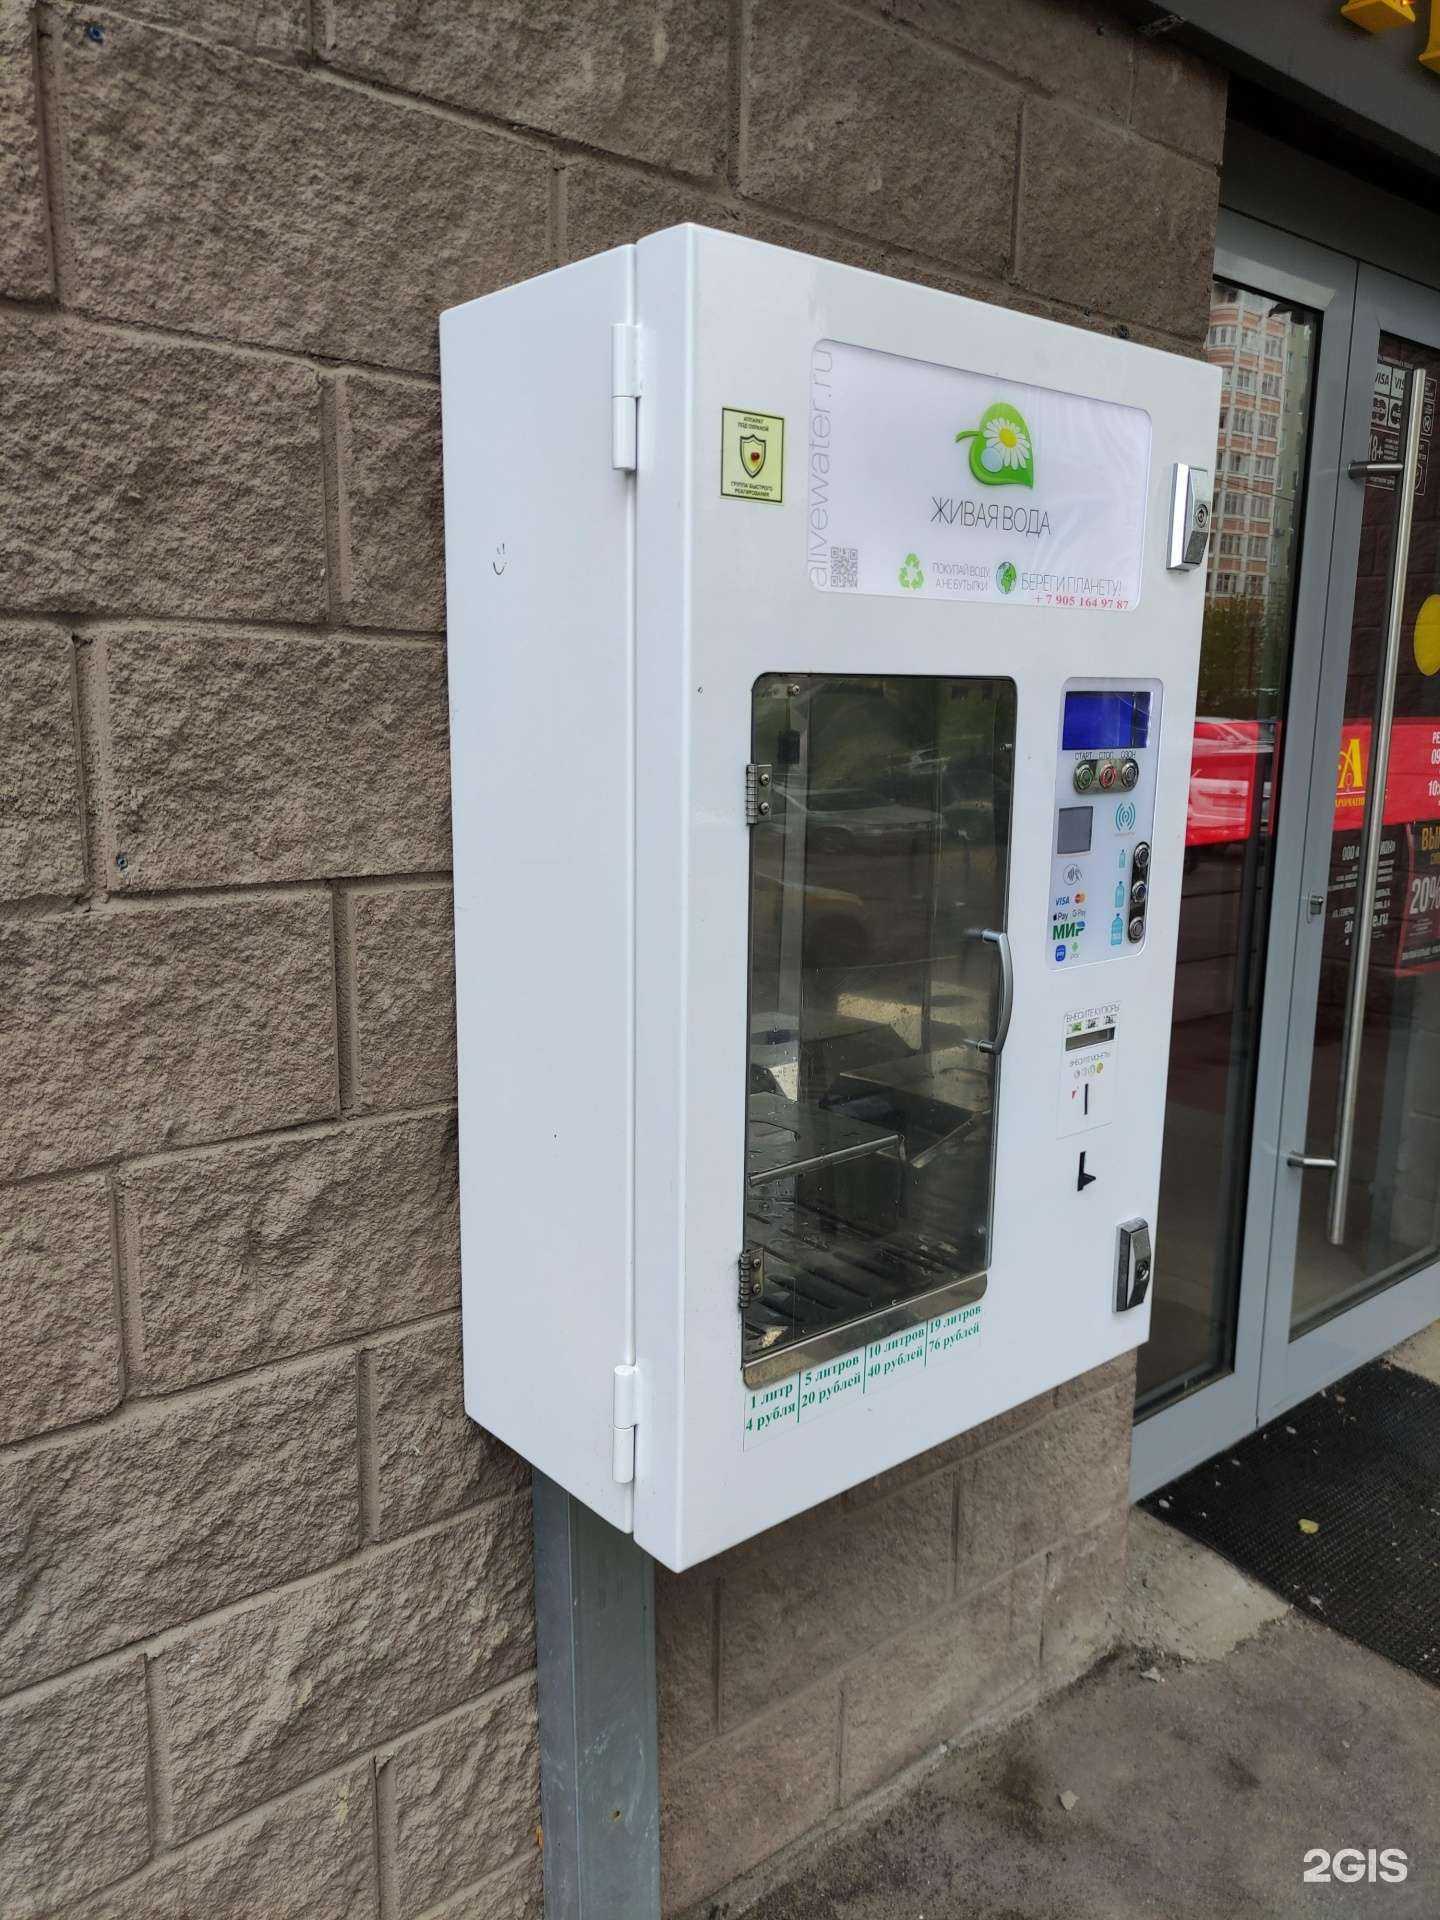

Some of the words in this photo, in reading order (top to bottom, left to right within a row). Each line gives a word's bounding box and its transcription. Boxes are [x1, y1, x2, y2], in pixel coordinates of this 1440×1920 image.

[808, 347, 833, 587] alivewater.ru
[930, 496, 999, 529] ЖИВАЯ
[1002, 505, 1051, 538] ВОДА
[932, 561, 969, 577] ПОКУПАЙ
[1021, 572, 1065, 592] БЕРЕГИ
[1068, 576, 1122, 597] ПЛАНЕТУ!
[1046, 594, 1052, 604] 7
[1056, 596, 1075, 606] 905
[1080, 597, 1098, 608] 164
[1101, 599, 1113, 609] 97
[1116, 600, 1129, 610] 87
[1056, 896, 1070, 906] VISA
[1053, 921, 1086, 940] МИР
[929, 1319, 941, 1334] 19
[943, 1303, 982, 1329] литров
[868, 1343, 881, 1359] 10
[883, 1328, 925, 1356] литров
[928, 1338, 941, 1353] 76
[943, 1321, 981, 1347] рублей
[805, 1373, 812, 1386] 5
[814, 1354, 860, 1382] литров
[867, 1362, 881, 1377] 40
[883, 1346, 923, 1376] рублей
[751, 1395, 756, 1409] 1
[760, 1382, 794, 1406] литр
[801, 1392, 815, 1408] 20
[818, 1372, 862, 1404] рублей
[745, 1417, 753, 1432] 4
[756, 1403, 796, 1430] рубля
